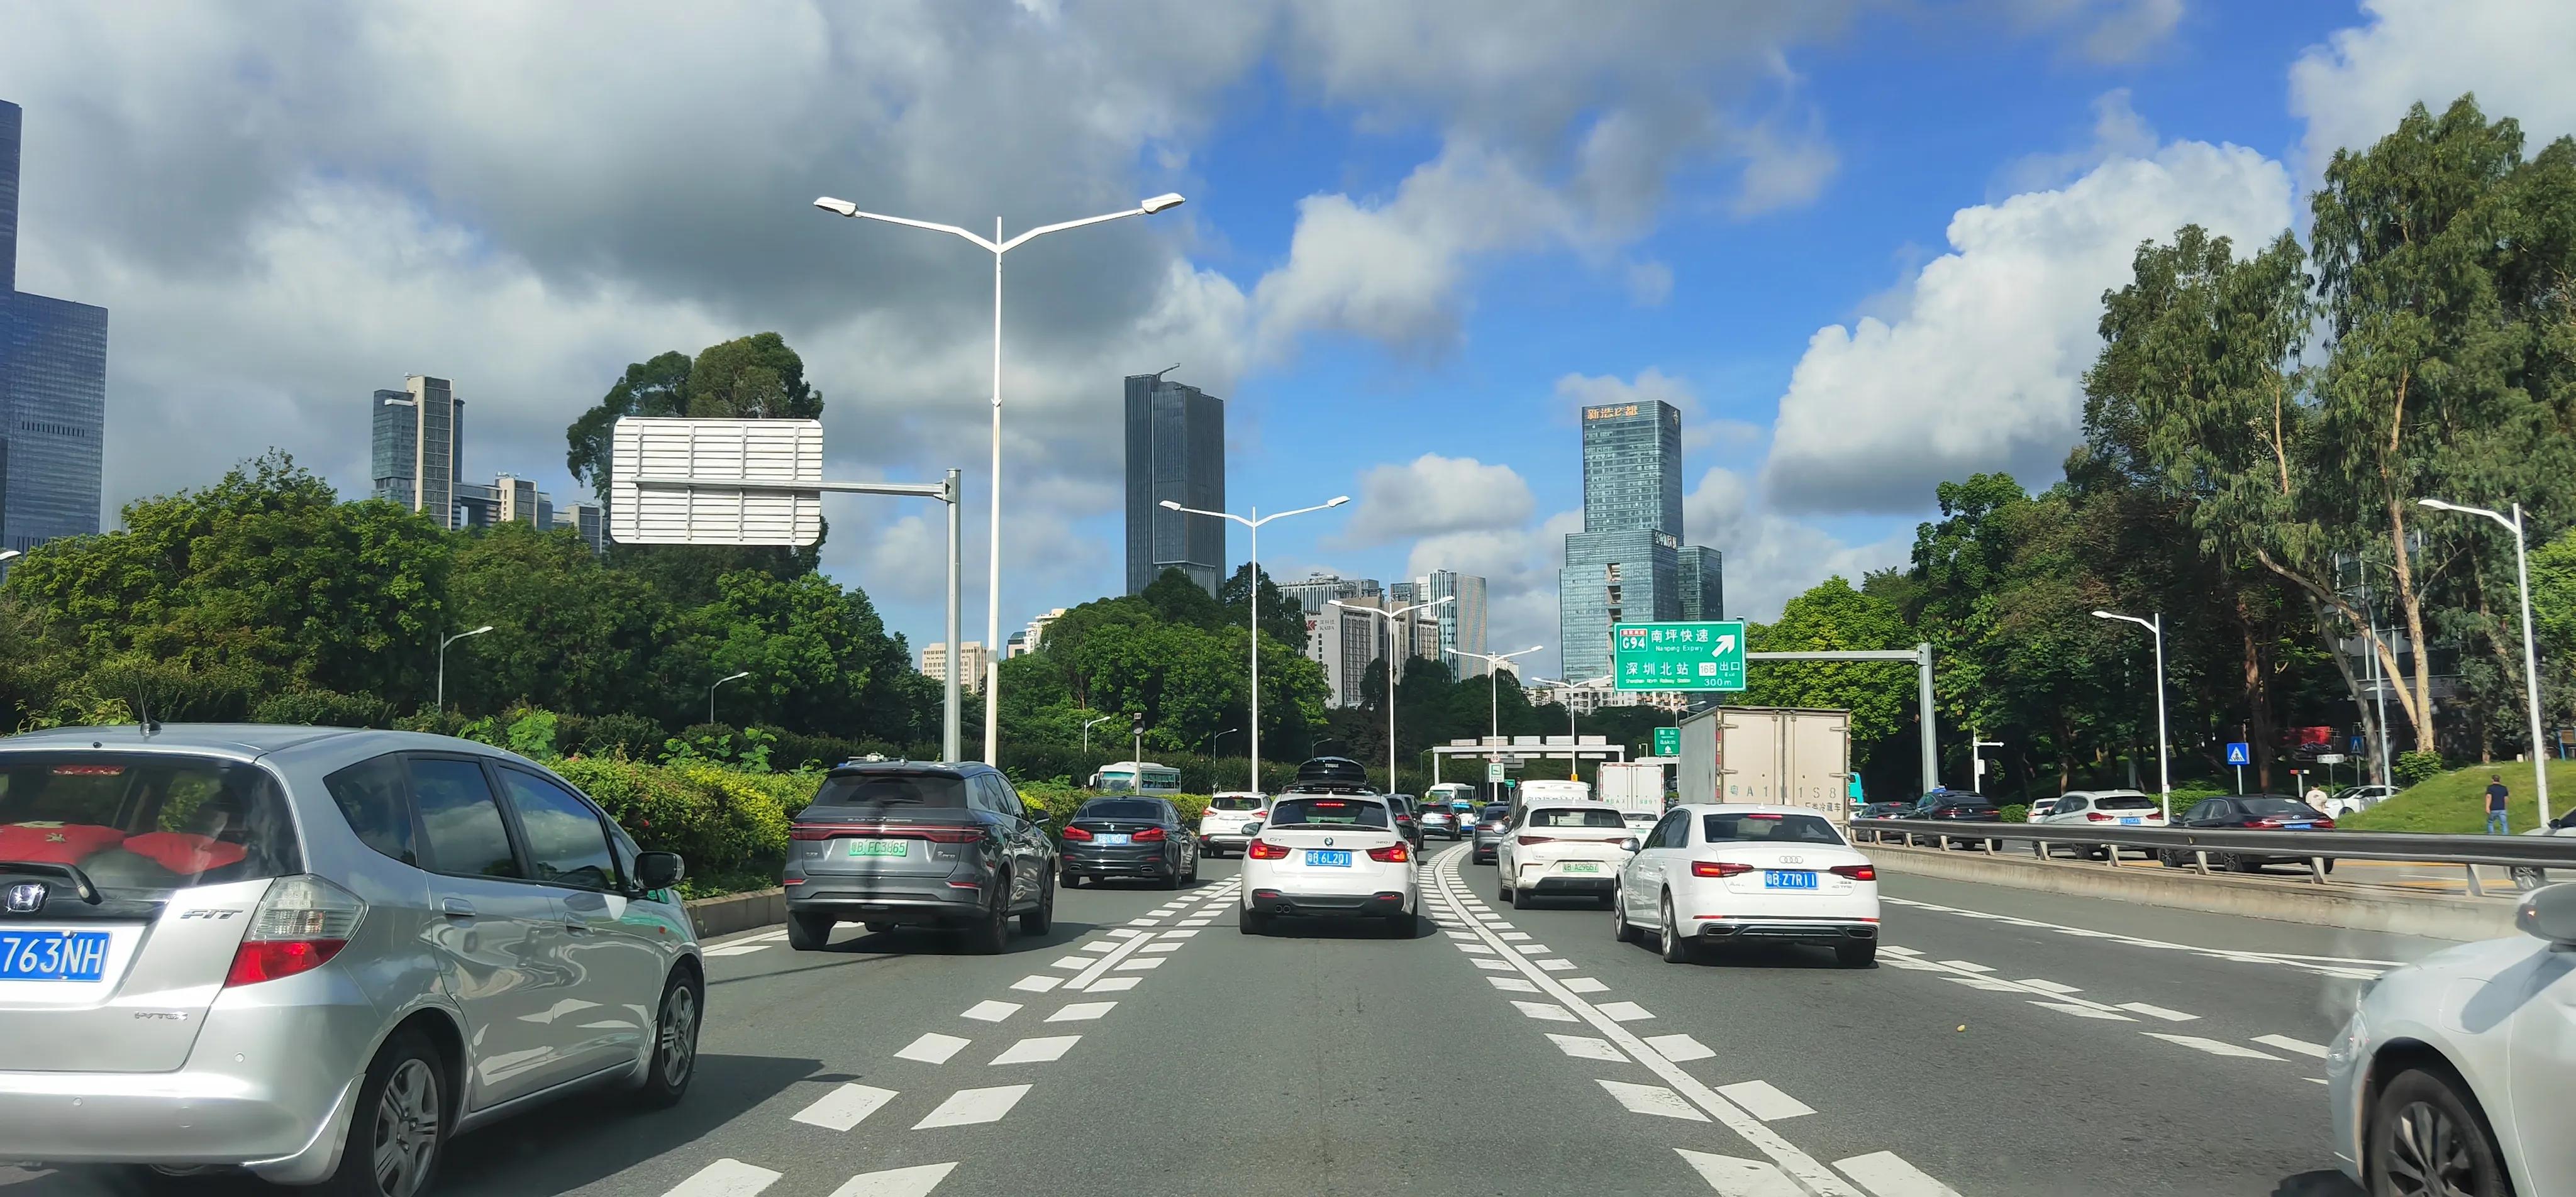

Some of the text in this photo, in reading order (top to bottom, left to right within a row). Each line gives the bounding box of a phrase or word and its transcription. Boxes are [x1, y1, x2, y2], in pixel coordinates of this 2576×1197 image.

[1650, 629, 1709, 643] 南坪快速
[1622, 637, 1645, 649] G94
[1625, 661, 1689, 676] 深圳北站
[1700, 665, 1716, 674] 16B
[1719, 661, 1740, 671] 出口
[180, 908, 245, 920] FIT
[3, 937, 108, 974] 763NH
